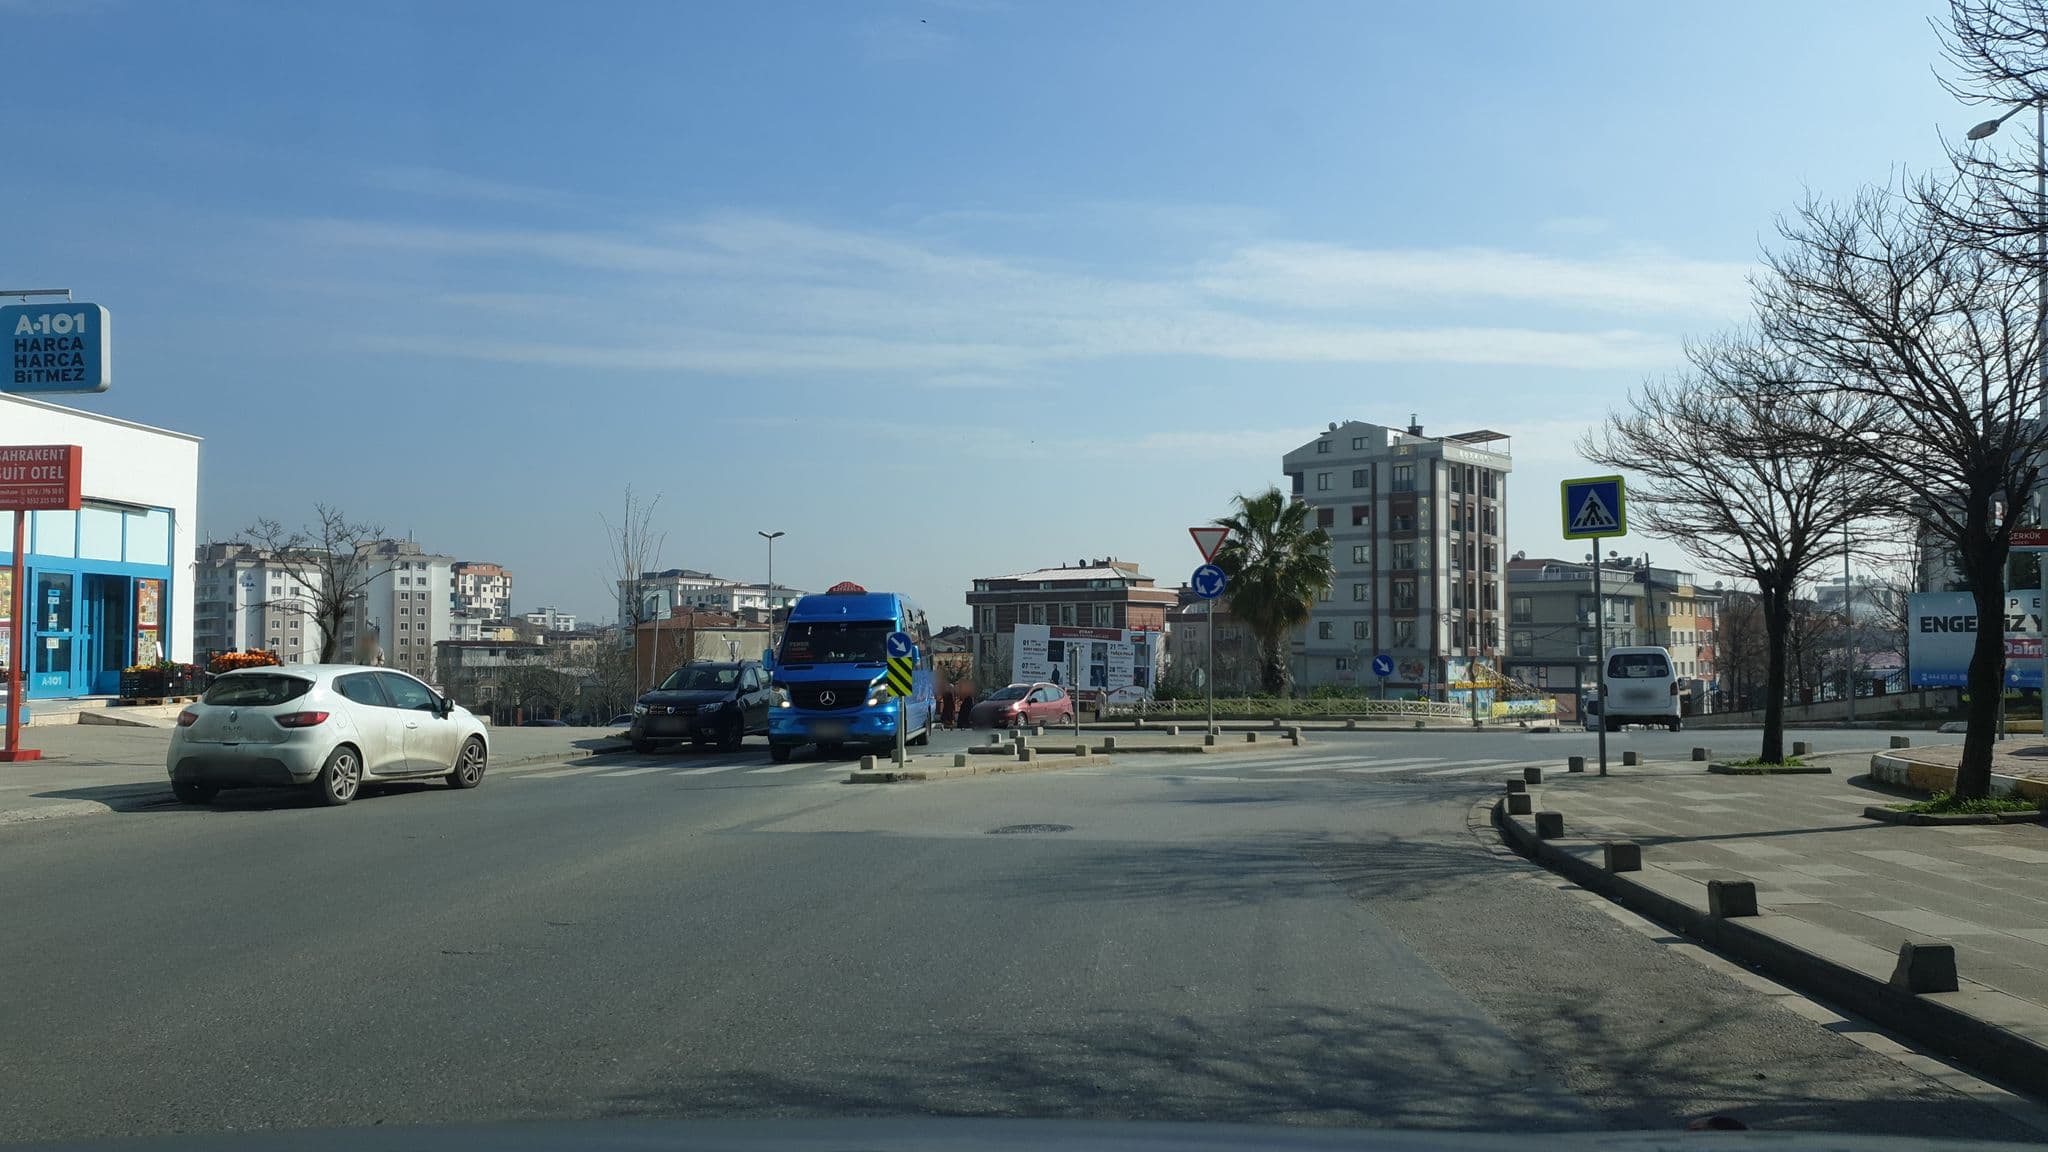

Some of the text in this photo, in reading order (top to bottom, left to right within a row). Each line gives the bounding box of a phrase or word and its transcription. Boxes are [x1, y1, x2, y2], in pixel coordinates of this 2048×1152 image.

[14, 337, 84, 352] HARCA
[14, 352, 84, 368] HARCA
[14, 368, 85, 383] BİTMEZ
[0, 464, 65, 480] UİT OTEL
[1920, 614, 2026, 633] ENGEİZ
